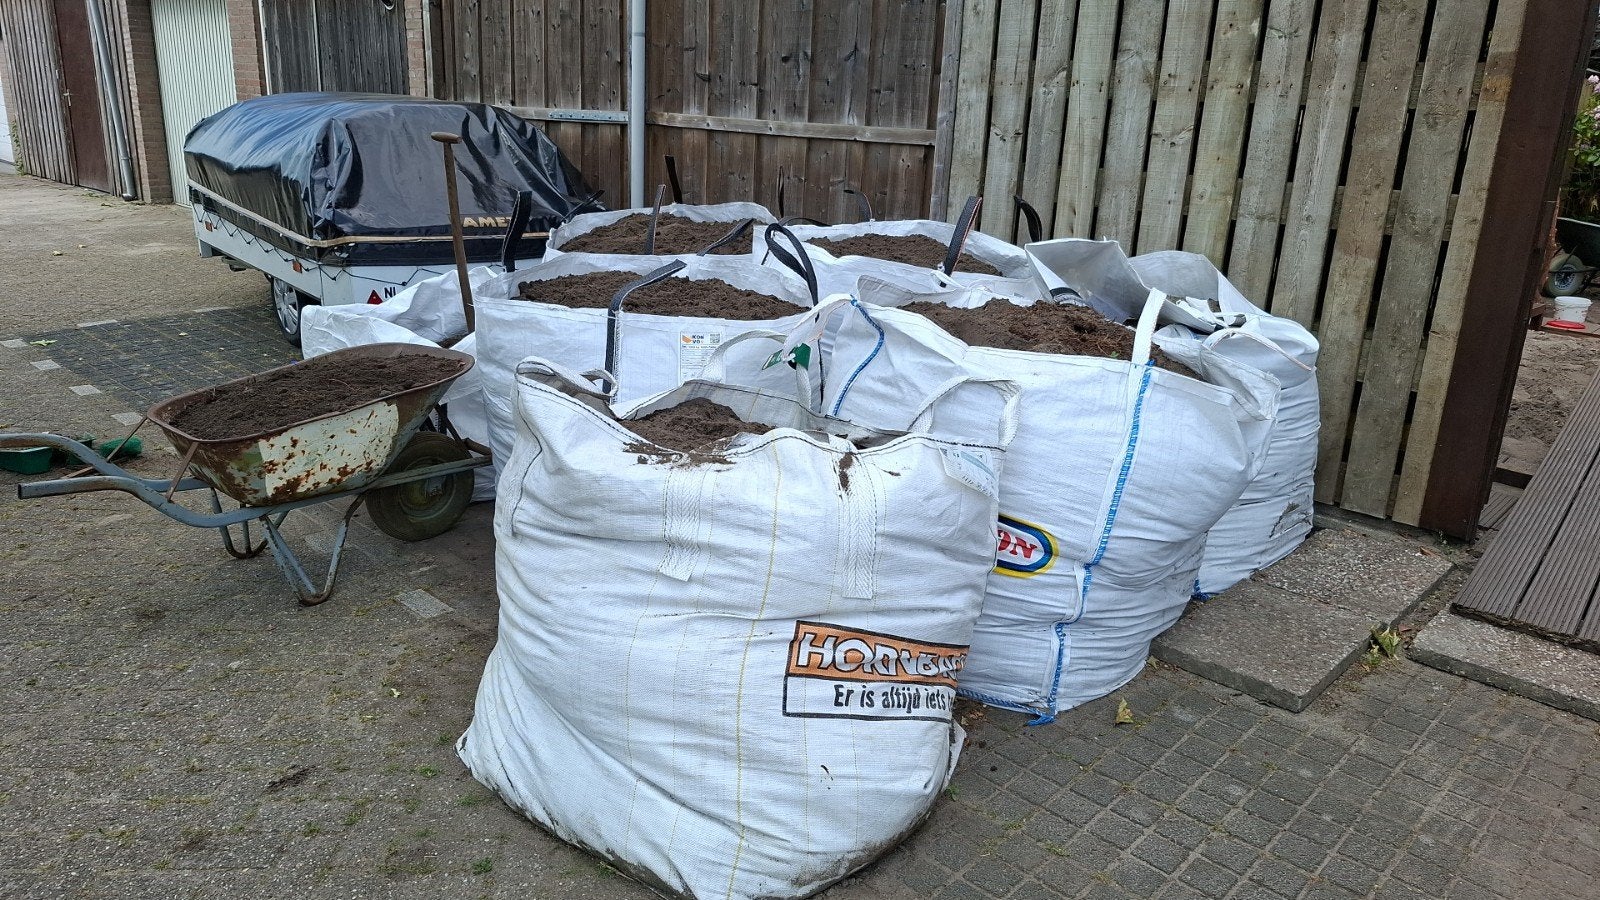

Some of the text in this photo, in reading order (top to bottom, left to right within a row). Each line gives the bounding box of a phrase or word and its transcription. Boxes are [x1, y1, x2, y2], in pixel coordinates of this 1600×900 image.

[463, 216, 511, 228] AME
[833, 684, 854, 707] Er
[860, 685, 875, 708] is
[881, 686, 921, 713] altijd
[925, 688, 946, 711] iets
